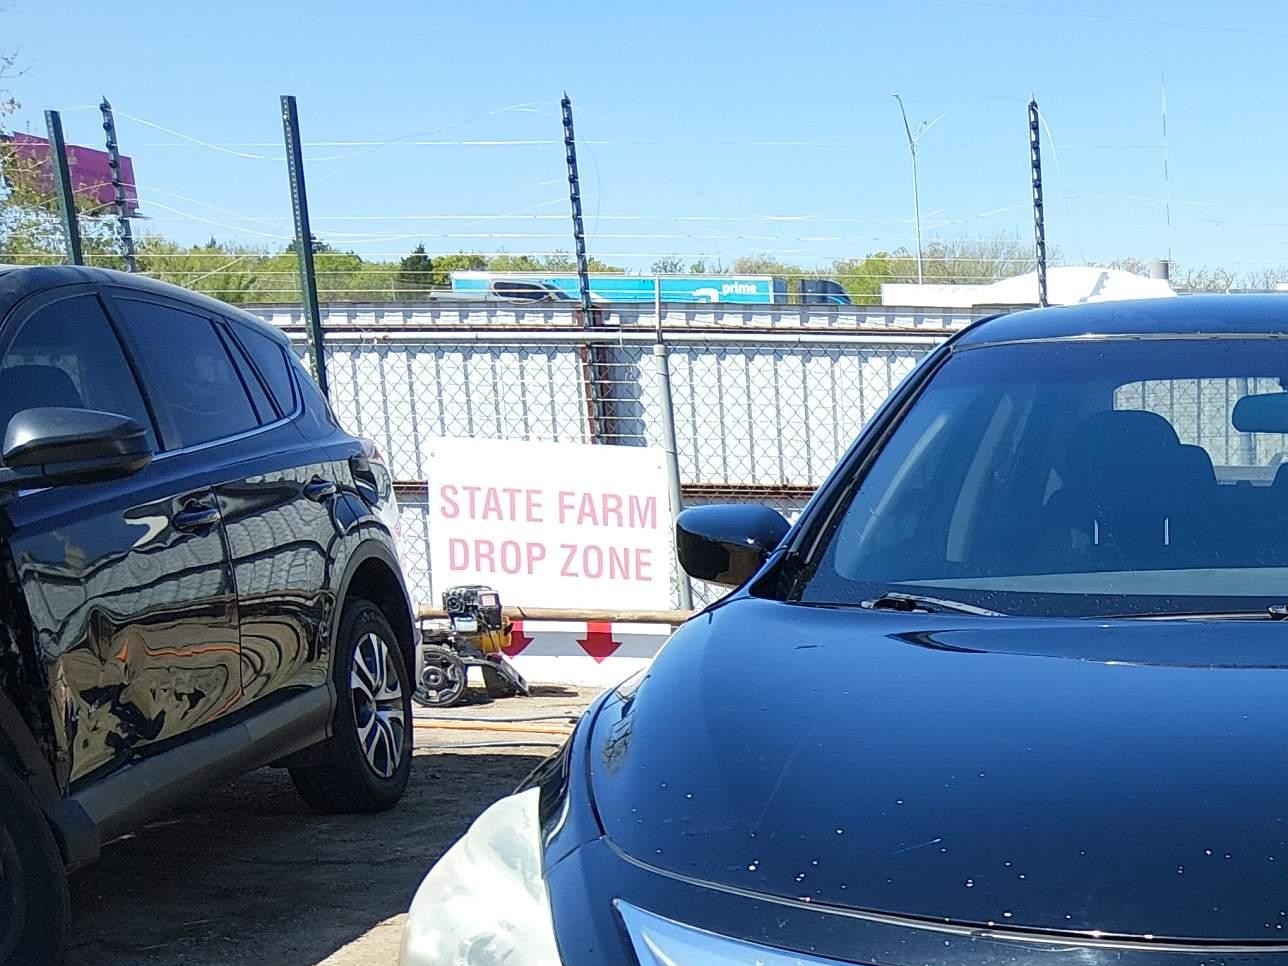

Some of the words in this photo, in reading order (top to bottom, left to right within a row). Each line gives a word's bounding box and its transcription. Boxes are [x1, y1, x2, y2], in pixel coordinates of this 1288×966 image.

[722, 281, 757, 296] prime
[440, 484, 544, 523] STATE
[558, 490, 657, 529] FARM
[449, 538, 546, 575] DROP
[560, 543, 653, 581] ZONE
